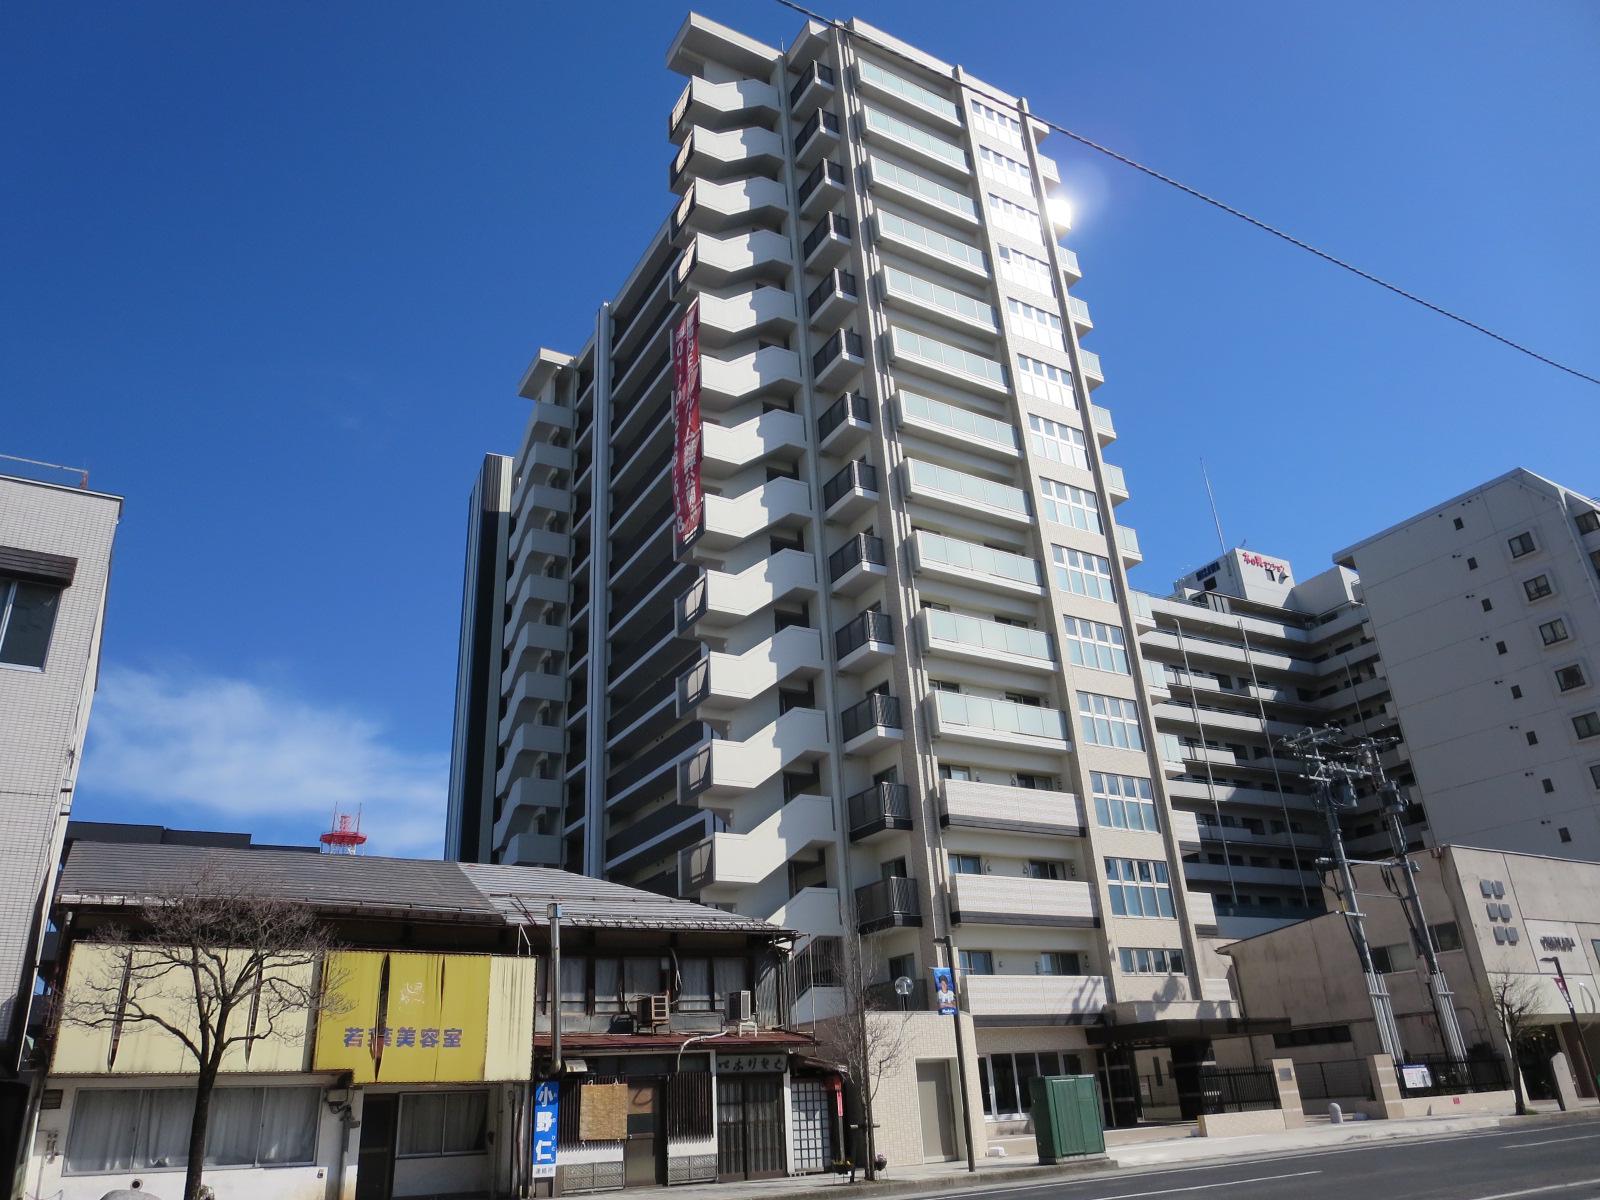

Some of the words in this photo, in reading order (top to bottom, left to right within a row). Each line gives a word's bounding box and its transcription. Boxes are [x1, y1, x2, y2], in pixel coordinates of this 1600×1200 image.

[344, 1027, 462, 1047] 若葉美容室
[535, 1086, 554, 1161] 小野仁
